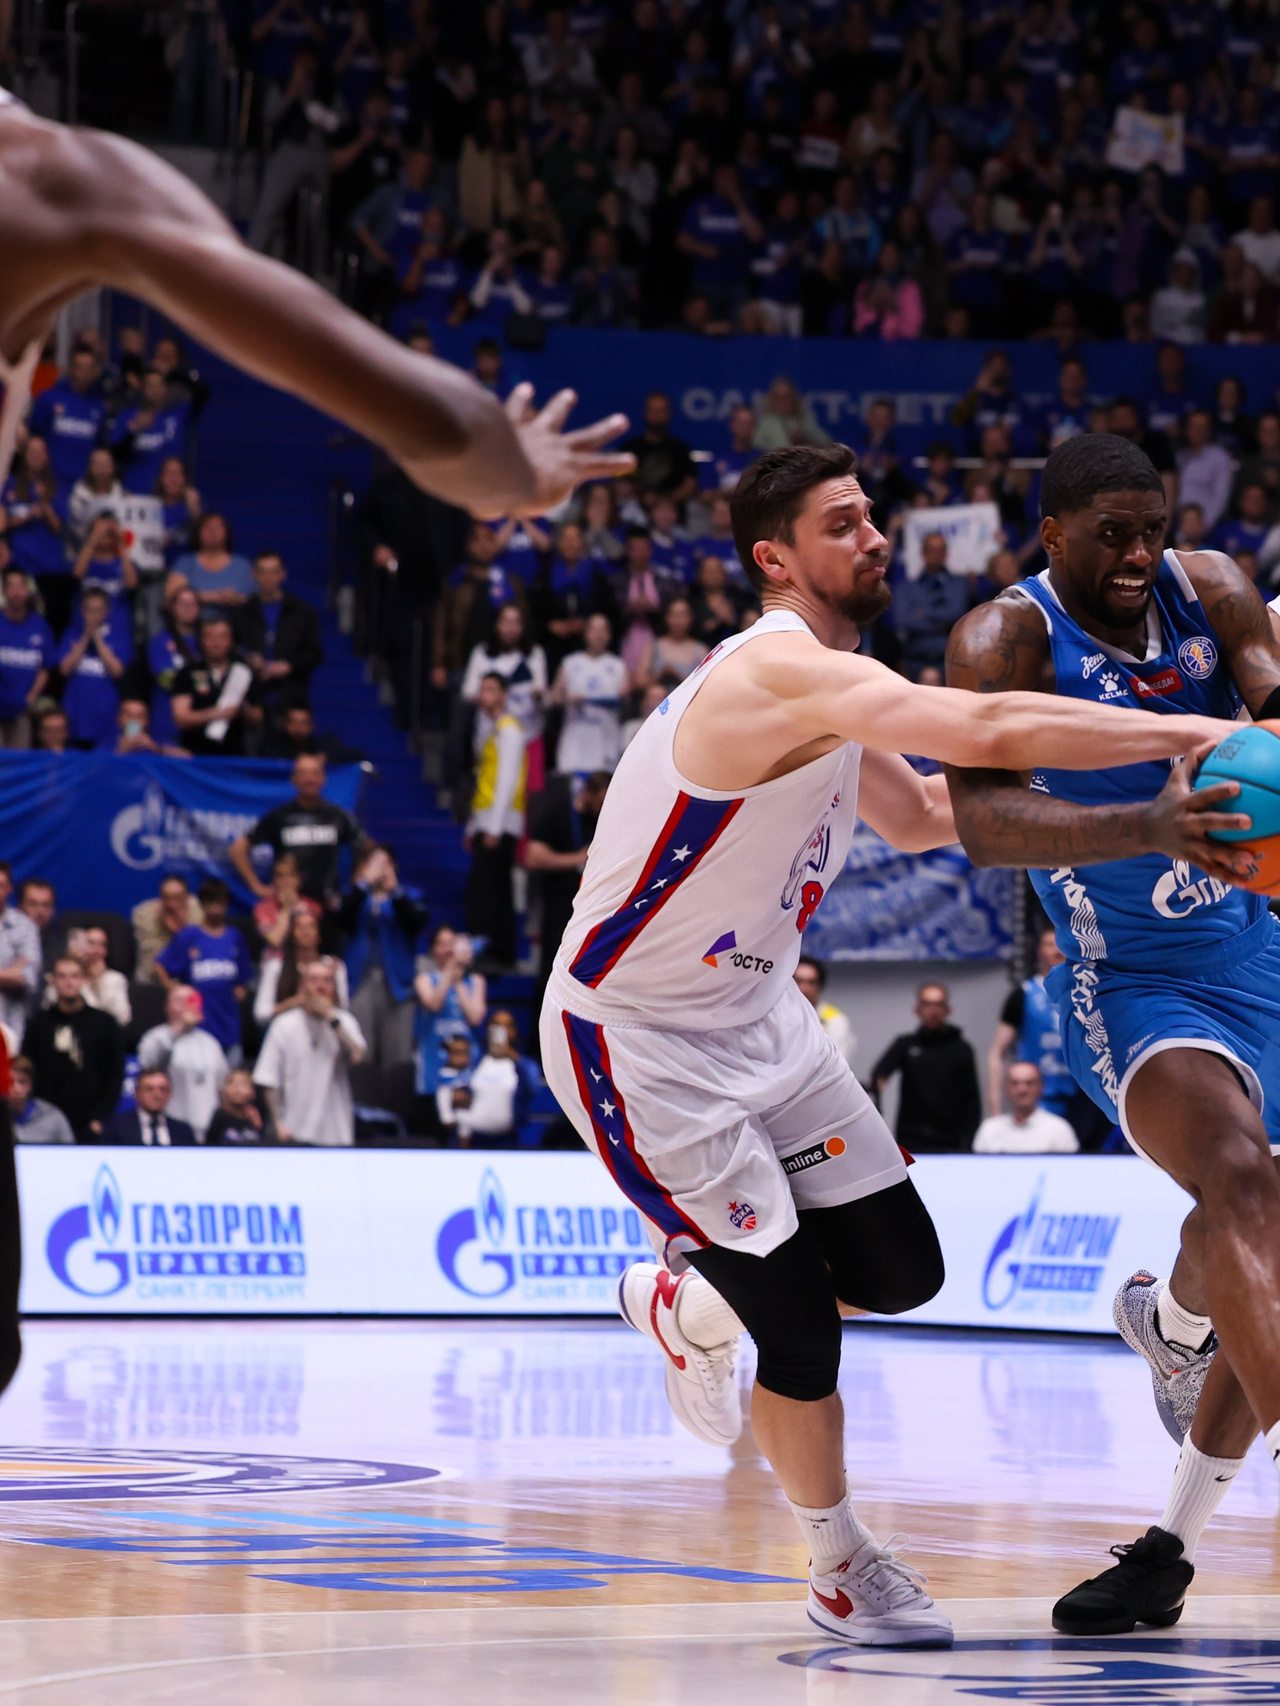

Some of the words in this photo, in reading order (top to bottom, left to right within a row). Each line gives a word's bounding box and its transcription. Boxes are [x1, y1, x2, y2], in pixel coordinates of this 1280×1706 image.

[1098, 688, 1129, 702] KELME
[1197, 875, 1232, 906] ГА
[795, 879, 824, 934] 8
[132, 1203, 304, 1244] ГАЗПРОМ
[516, 1206, 650, 1246] ГАЗПРО
[731, 1206, 753, 1225] CSKA
[139, 1253, 305, 1276] ТРАНСГАЗ
